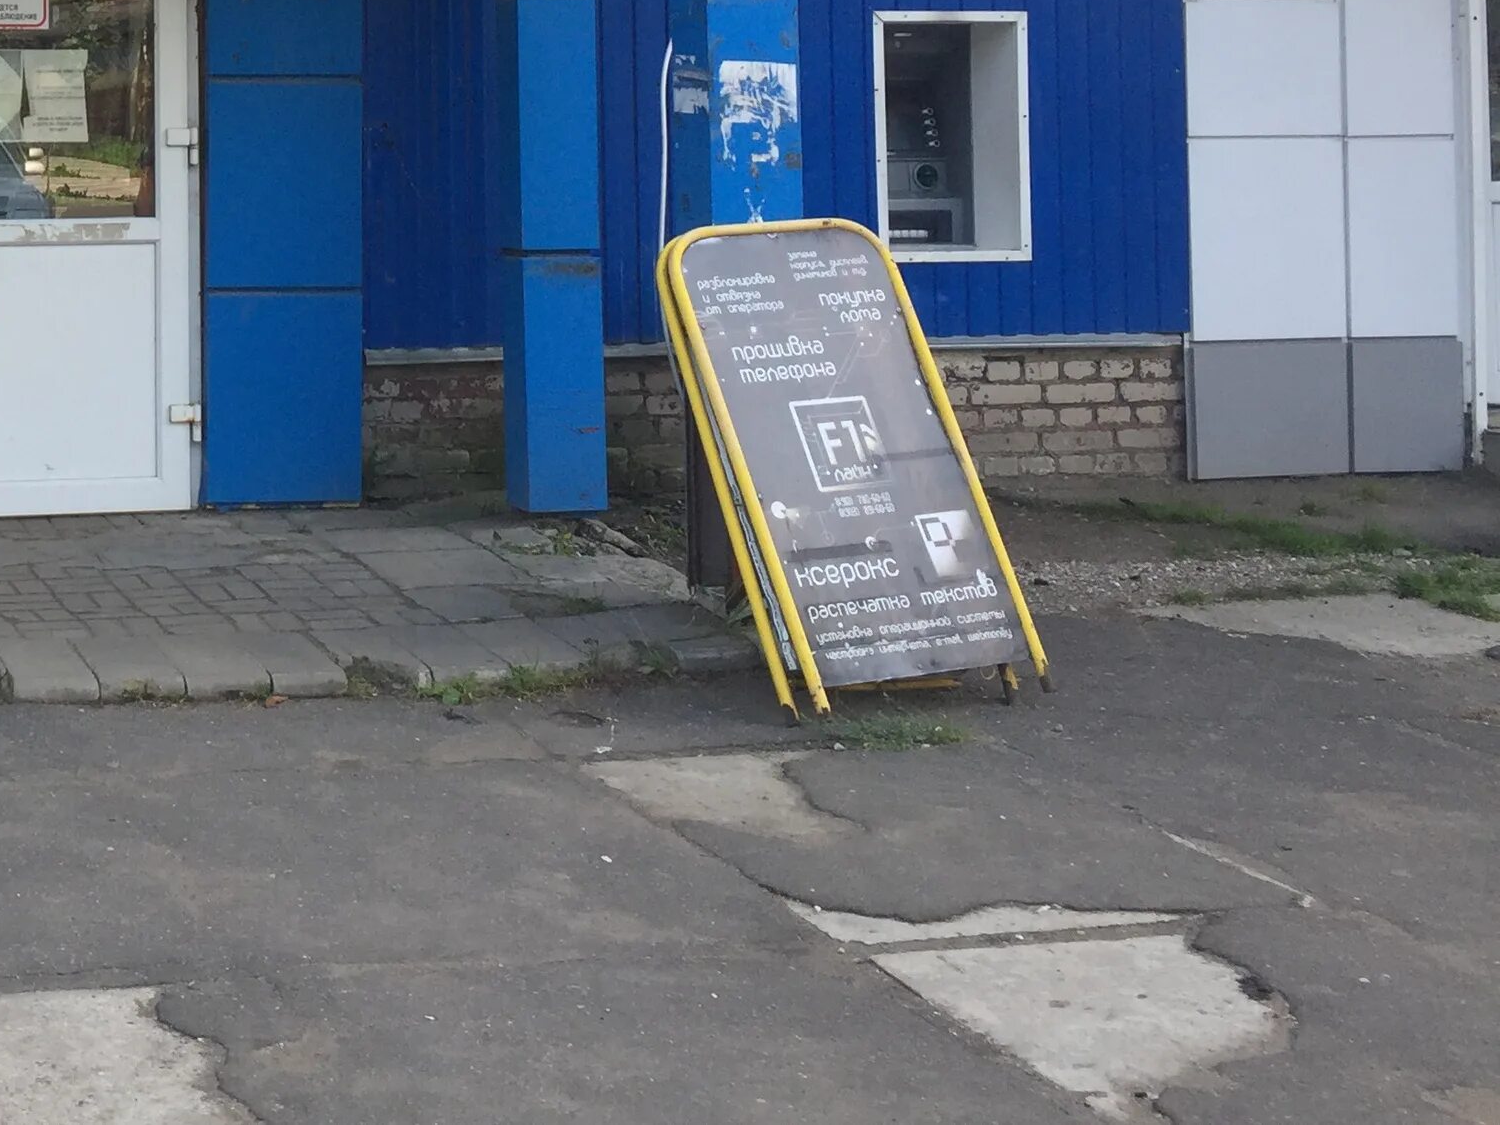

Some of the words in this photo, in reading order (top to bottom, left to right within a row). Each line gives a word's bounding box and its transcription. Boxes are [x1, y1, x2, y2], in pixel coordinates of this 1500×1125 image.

[697, 272, 776, 291] разблокировка
[702, 294, 711, 304] и
[716, 288, 762, 305] отвязка
[705, 305, 722, 315] от
[728, 300, 785, 315] оператора
[818, 289, 886, 309] покупка
[839, 307, 882, 324] лома
[731, 335, 825, 362] прошивка
[739, 360, 837, 385] телефона
[794, 557, 900, 589] ксерокс
[807, 593, 911, 624] распечатка
[920, 579, 998, 606] текстов
[816, 625, 873, 647] установка
[957, 610, 1007, 625] системы
